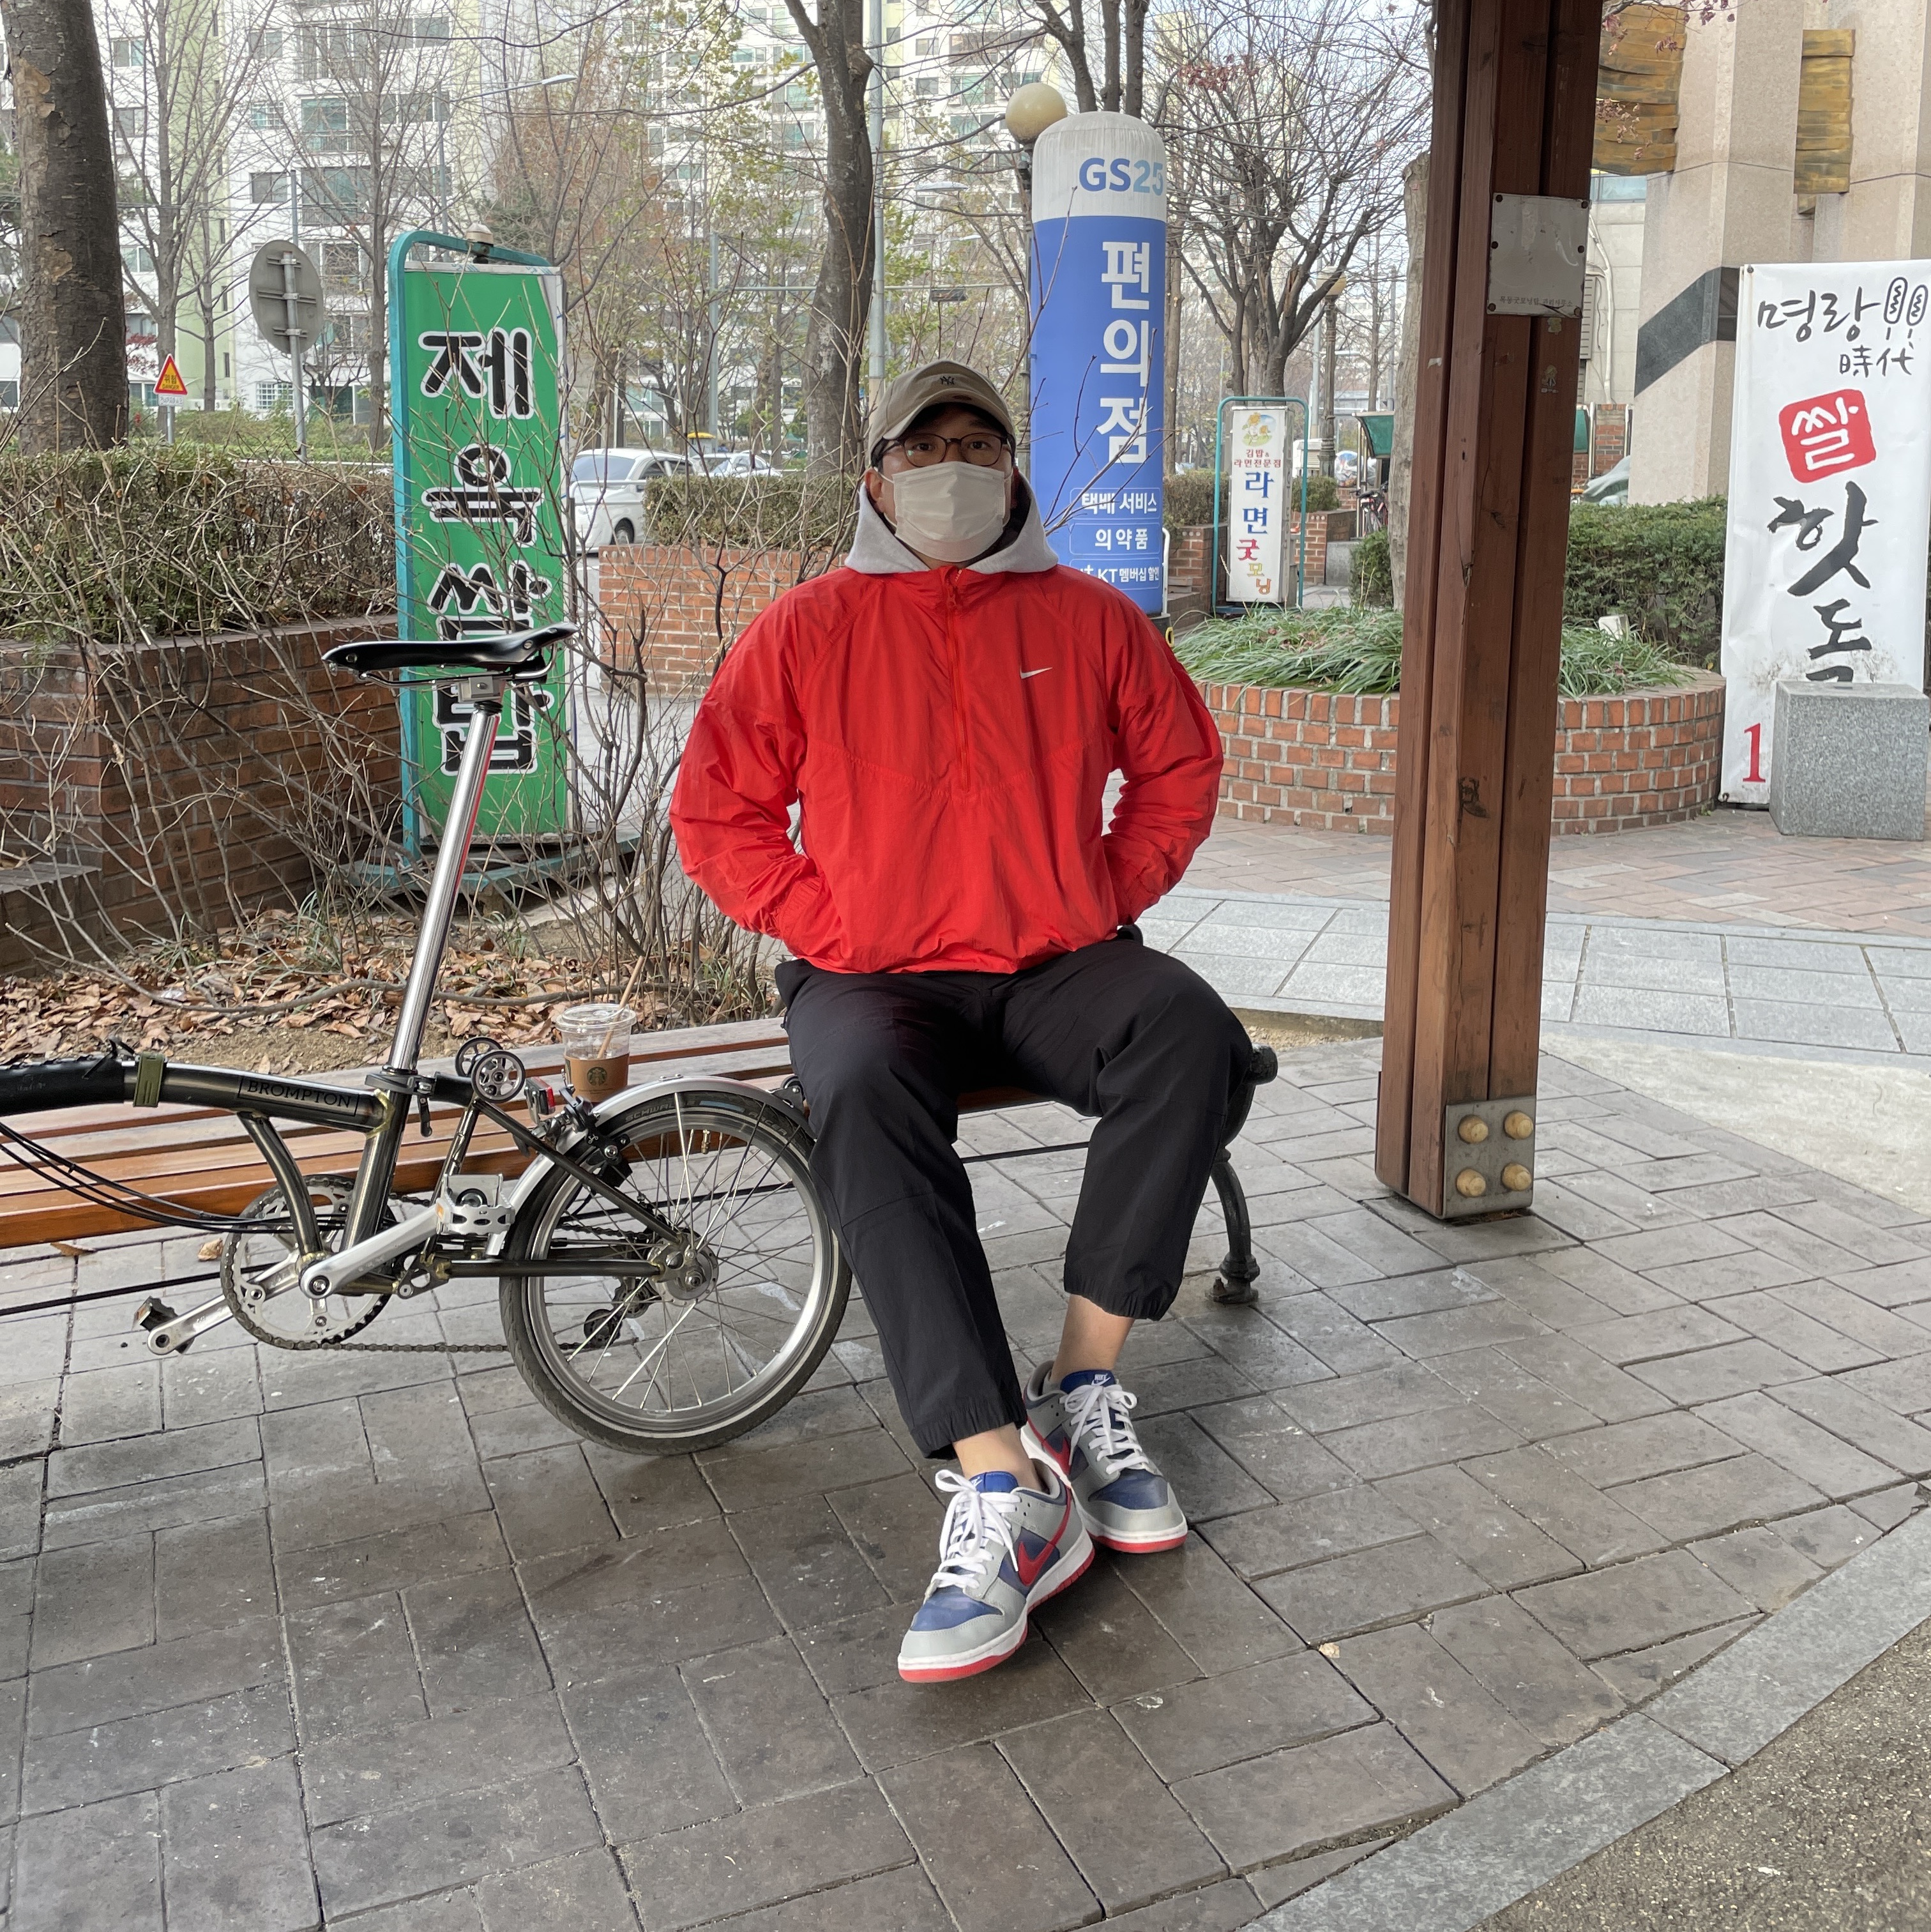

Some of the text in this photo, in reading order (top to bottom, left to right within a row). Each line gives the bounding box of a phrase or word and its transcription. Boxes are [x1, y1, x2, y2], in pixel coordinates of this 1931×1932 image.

[1079, 158, 1163, 196] GS25
[1757, 285, 1881, 342] 명랑
[1098, 241, 1149, 465] 편의점
[1839, 340, 1914, 378] 時代
[1791, 395, 1860, 471] 쌀
[1234, 459, 1282, 468] 라면전문점
[1081, 492, 1157, 515] 택배 서비스
[1094, 528, 1148, 551] 의약품
[1236, 471, 1275, 595] 라면 굿모닝
[1098, 568, 1118, 583] KT
[1119, 567, 1147, 583] 멤버십
[246, 1080, 351, 1108] BROMPTON
[625, 1100, 695, 1122] SCHWALE
